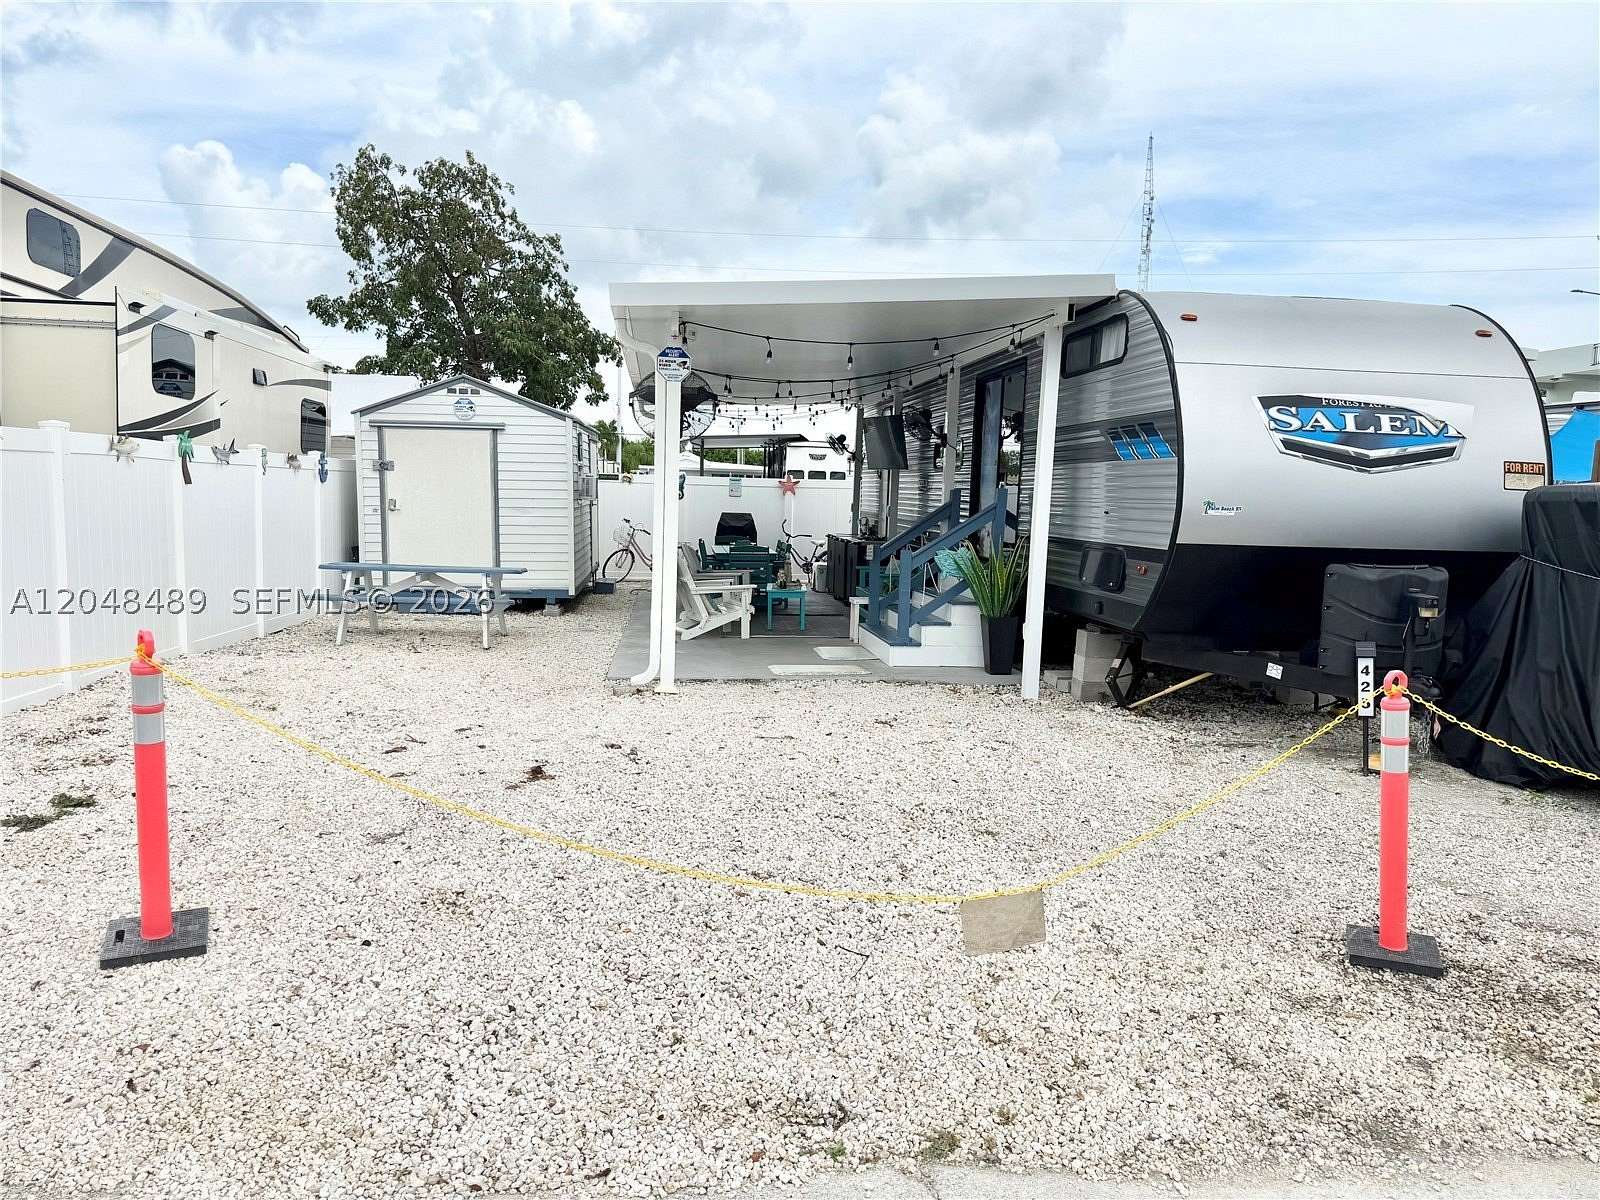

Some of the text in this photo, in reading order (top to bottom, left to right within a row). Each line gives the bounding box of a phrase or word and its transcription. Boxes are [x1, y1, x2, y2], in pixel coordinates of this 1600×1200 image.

[1267, 405, 1466, 439] SALEM
[1504, 462, 1544, 474] FOR RENT
